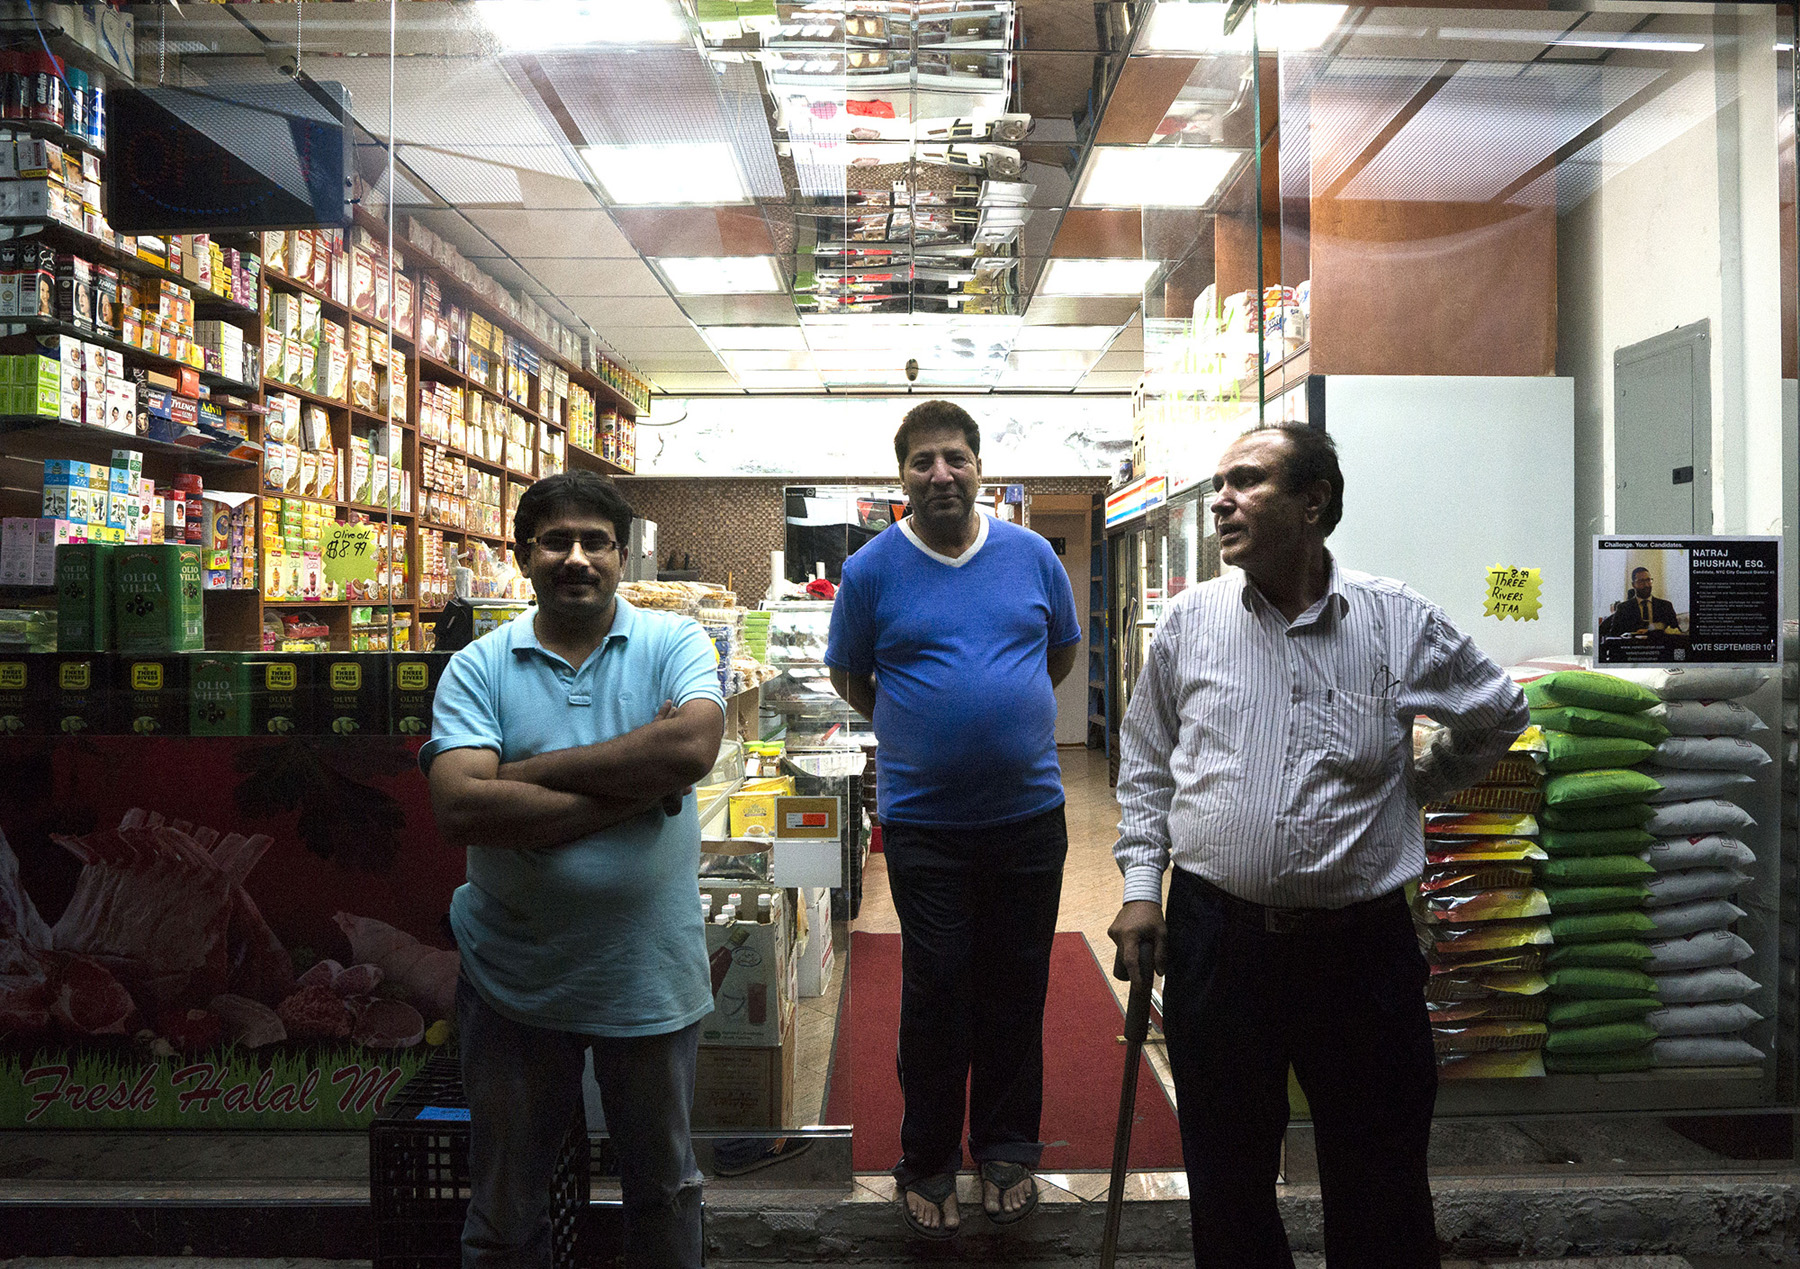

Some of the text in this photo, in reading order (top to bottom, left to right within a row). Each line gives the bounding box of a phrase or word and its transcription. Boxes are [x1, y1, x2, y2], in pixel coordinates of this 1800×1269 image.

[37, 73, 47, 104] Gillette
[171, 399, 196, 413] TYLENOL
[201, 402, 222, 416] Advil
[333, 529, 356, 539] Olive
[326, 539, 367, 560] $8.99
[1692, 549, 1728, 557] NATRAJ
[214, 556, 228, 566] ENO
[1692, 560, 1766, 568] BHUSHAN, ESQ.
[124, 573, 157, 582] OLIO
[180, 574, 200, 582] VILLA
[1511, 568, 1529, 578] 8.99
[212, 576, 226, 586] ENO
[120, 584, 162, 593] VILLA
[1494, 602, 1519, 614] ATAA
[197, 680, 230, 690] OLIO
[194, 690, 234, 700] VILLA
[22, 1063, 159, 1122] Fresh
[171, 1063, 322, 1114] Halal
